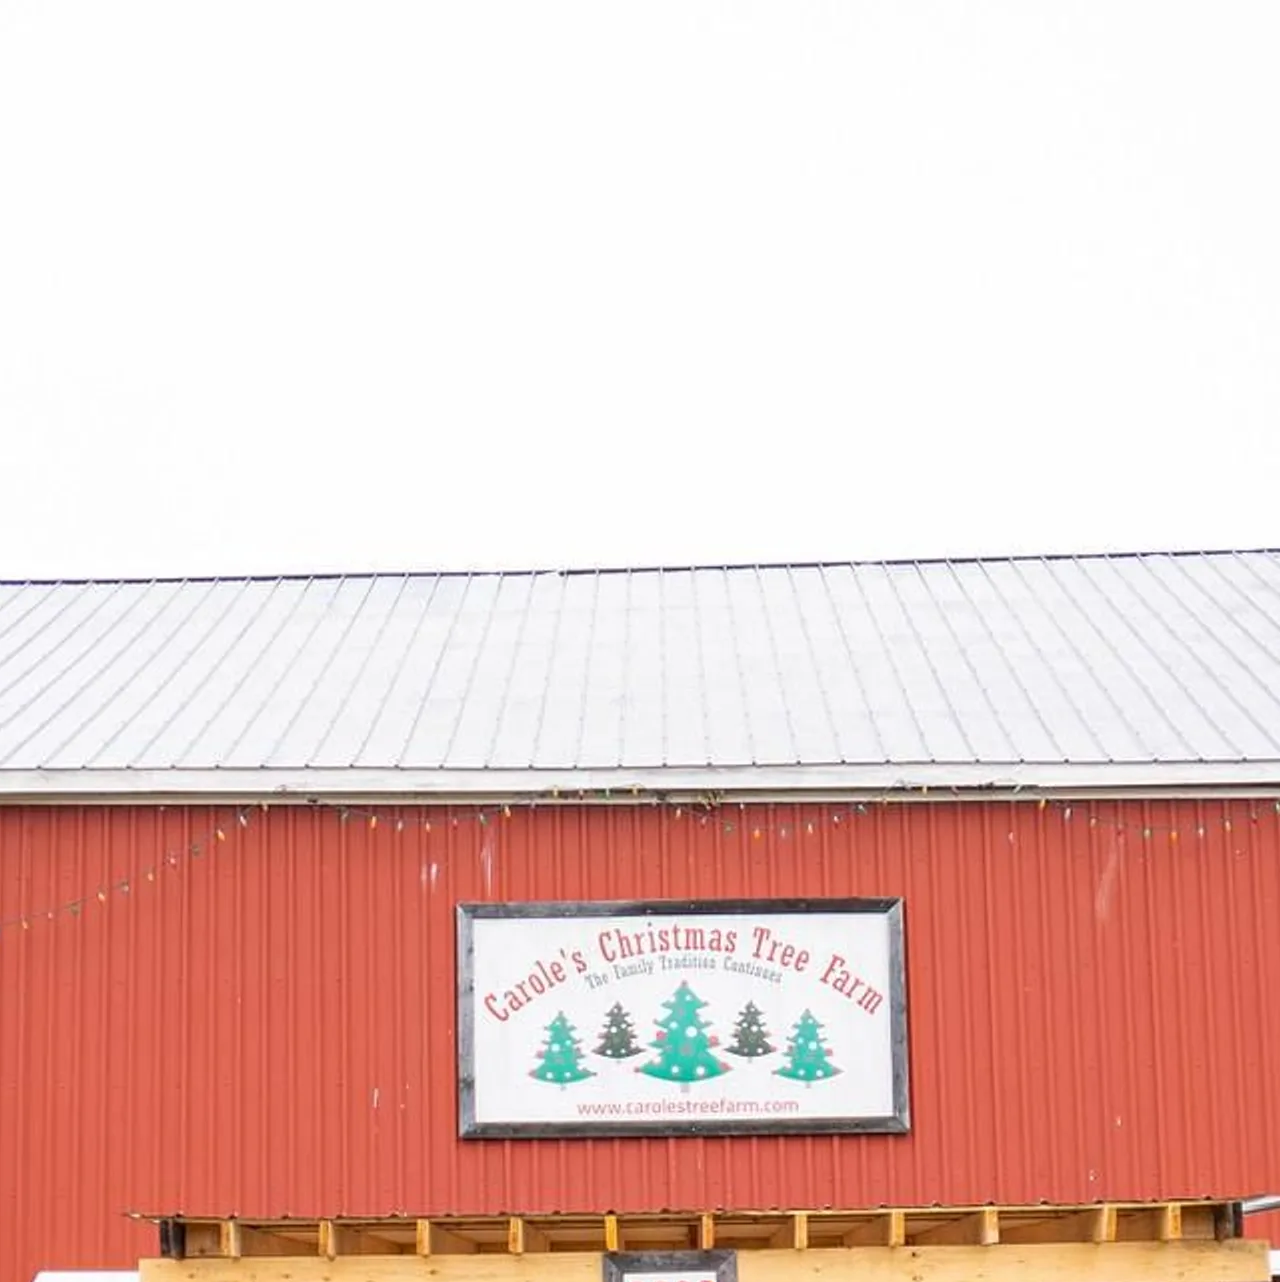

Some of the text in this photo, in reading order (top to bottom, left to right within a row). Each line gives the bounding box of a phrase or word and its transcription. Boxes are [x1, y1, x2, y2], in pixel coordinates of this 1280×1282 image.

[483, 921, 884, 1023] Carole's Christmas Tree Farm
[586, 954, 783, 990] The Family Tradition Continues
[577, 1097, 799, 1116] www.carolestreefarm.com
